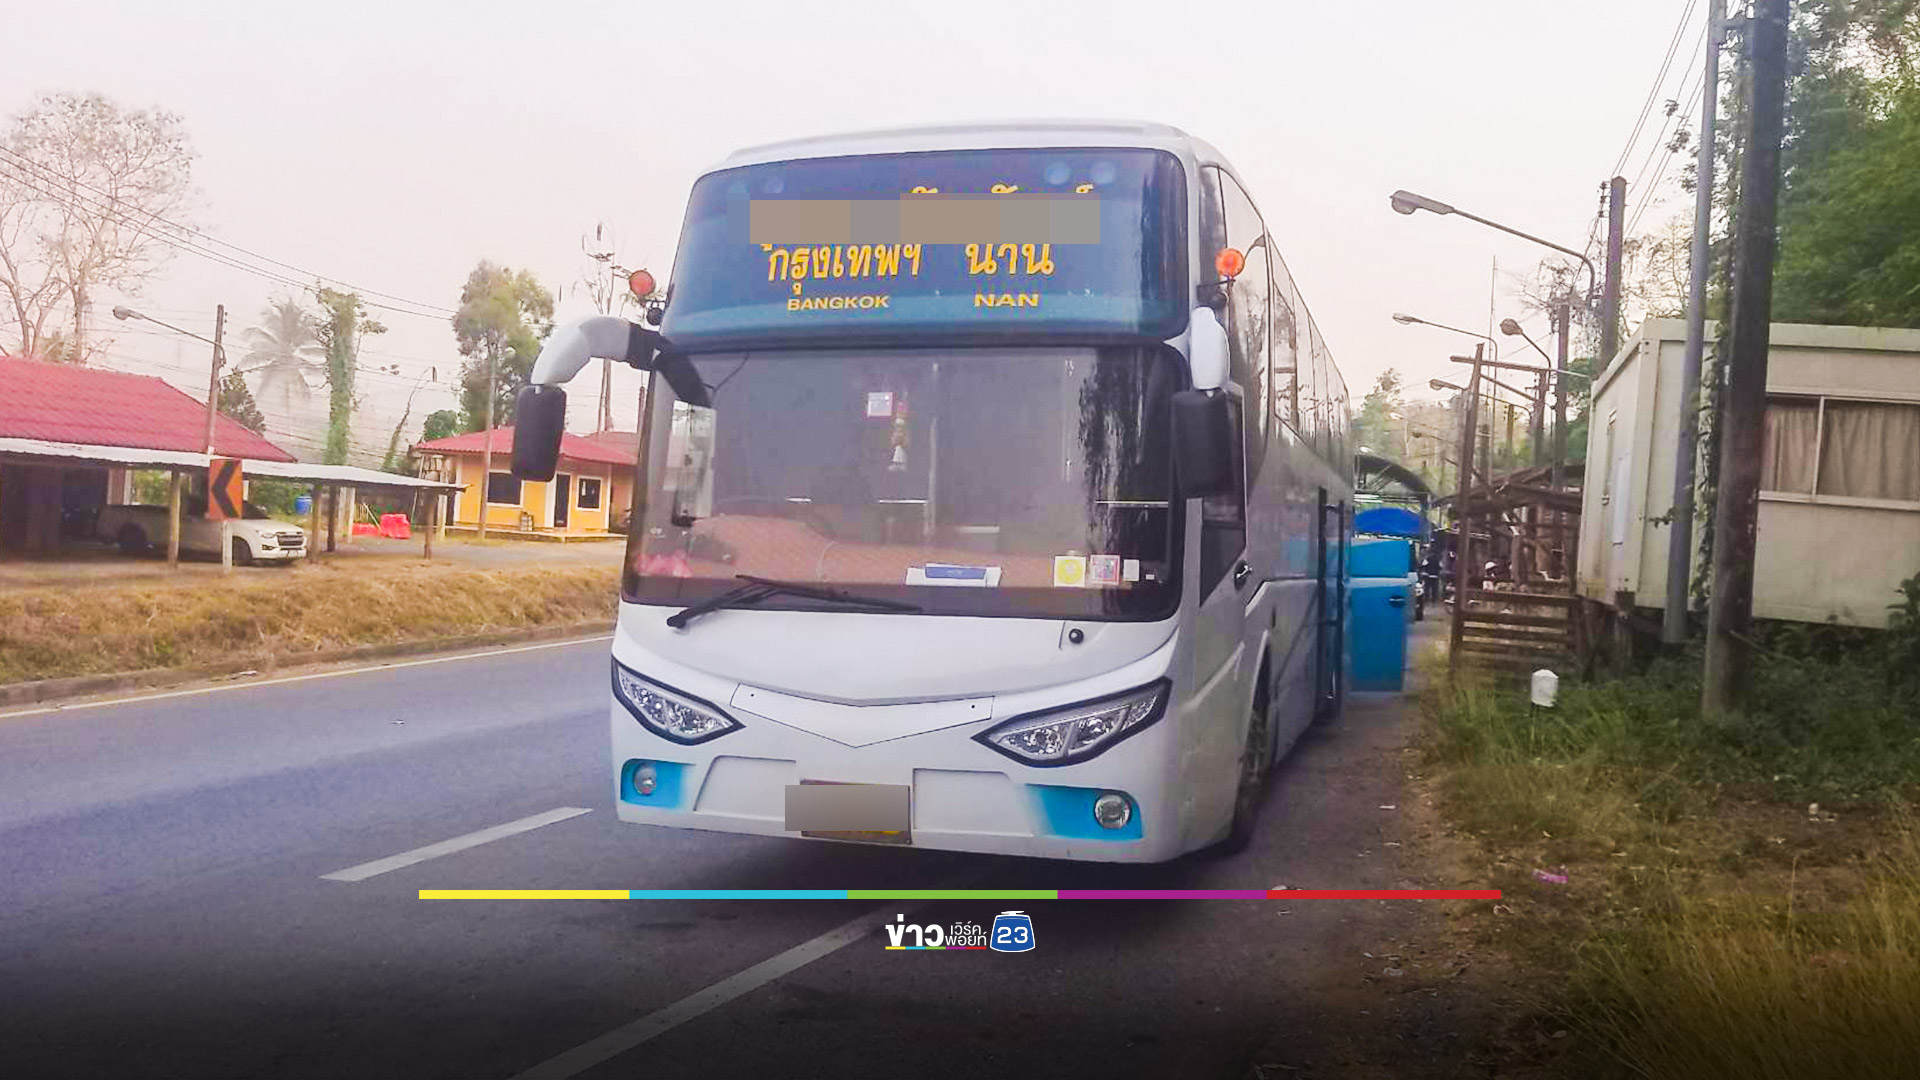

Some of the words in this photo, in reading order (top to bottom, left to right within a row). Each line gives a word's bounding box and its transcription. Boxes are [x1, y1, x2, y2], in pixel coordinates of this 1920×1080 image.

[767, 243, 922, 296] กรุงเทพฯ
[787, 295, 889, 312] BANGKOK
[974, 293, 1039, 308] NAN
